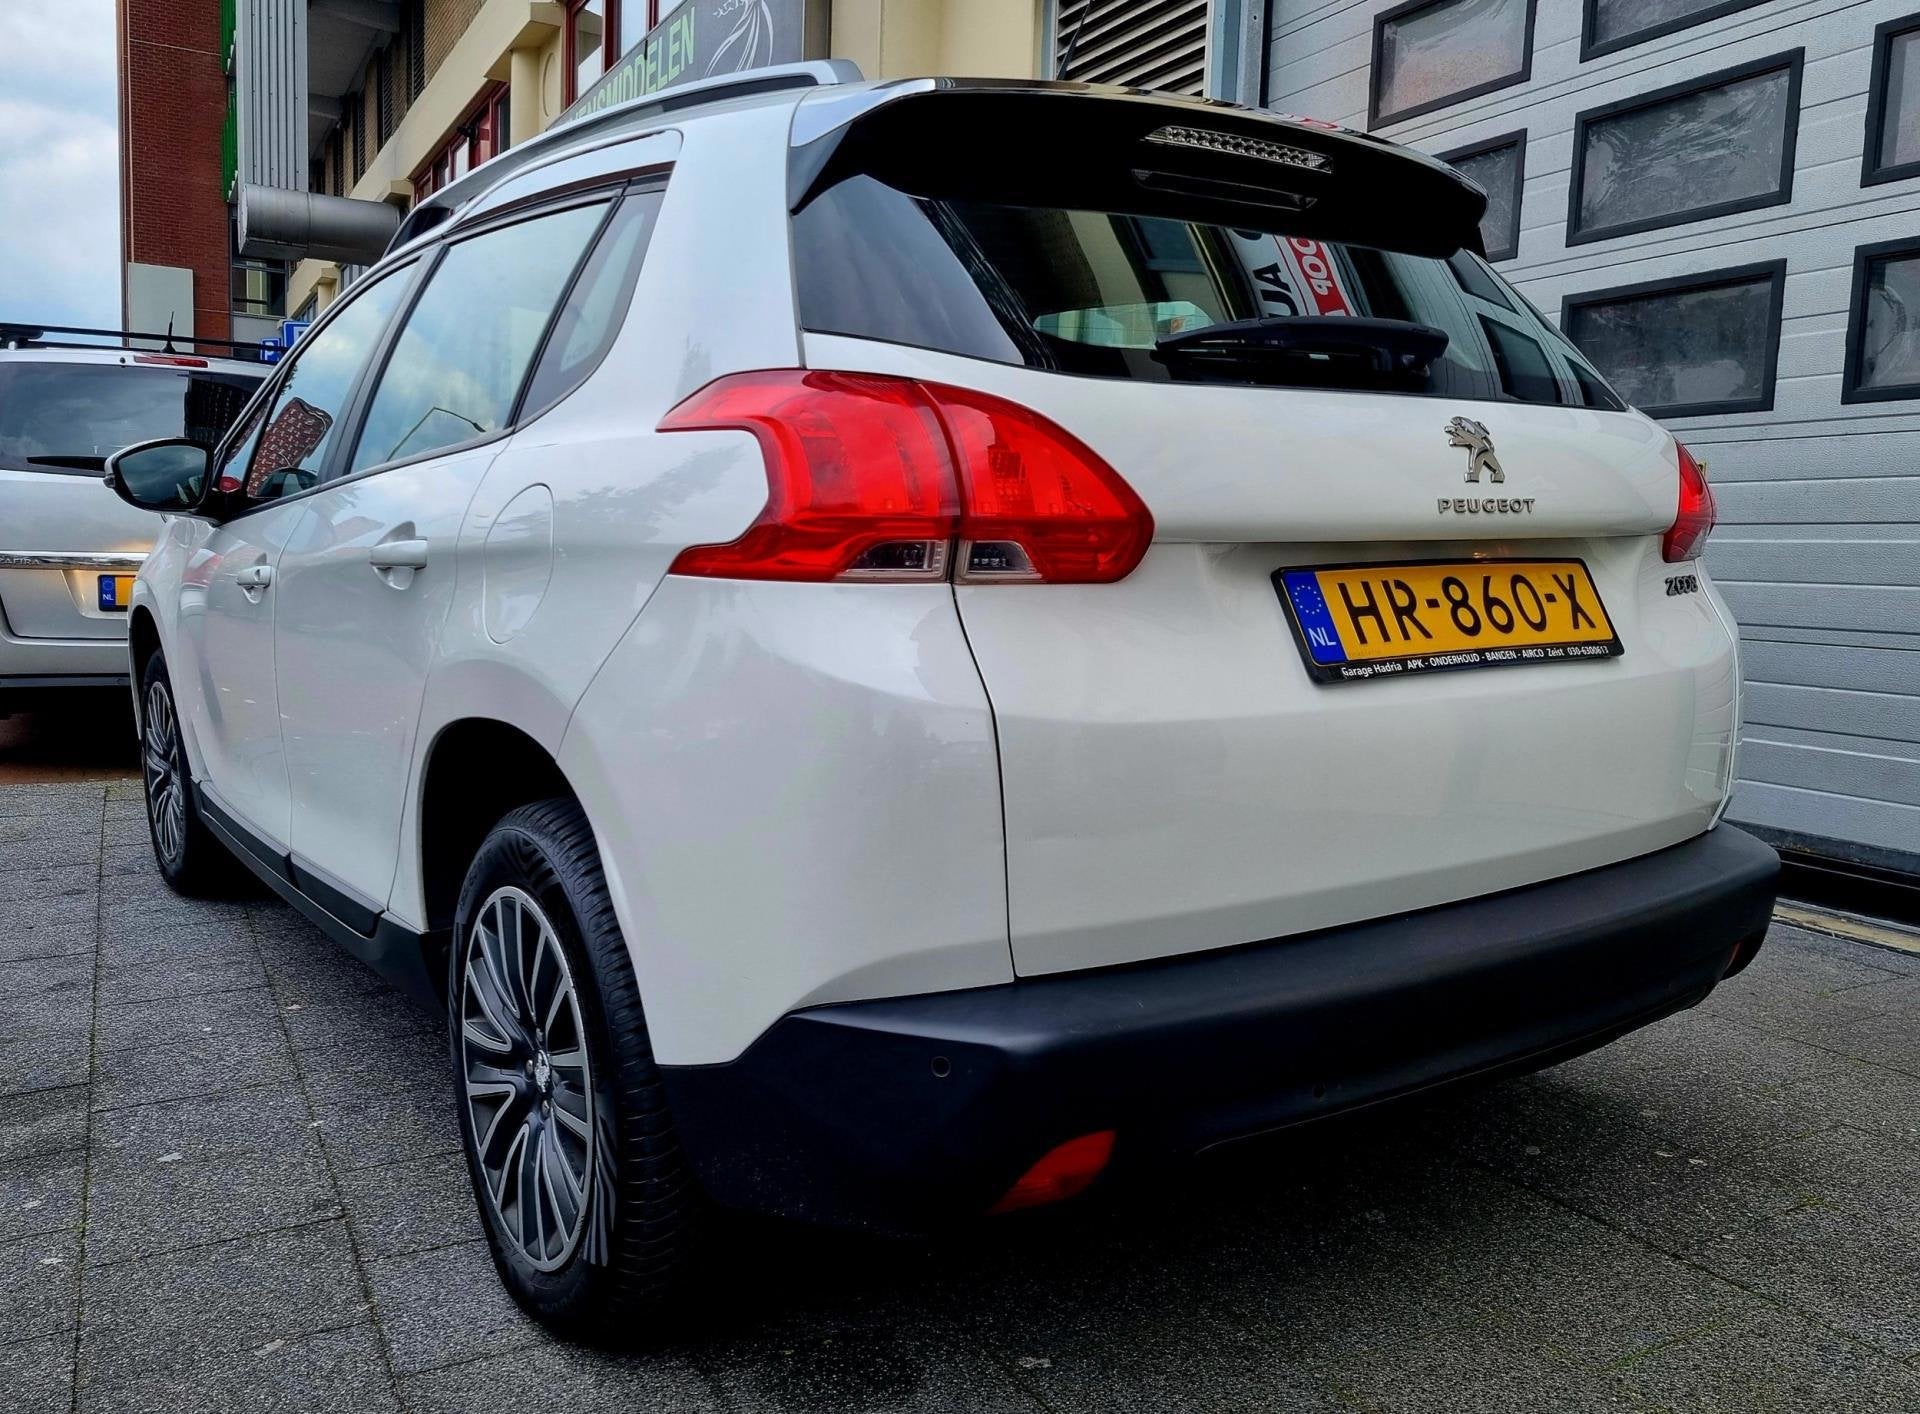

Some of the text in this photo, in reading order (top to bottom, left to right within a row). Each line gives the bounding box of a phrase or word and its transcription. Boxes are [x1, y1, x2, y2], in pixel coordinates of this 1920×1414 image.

[1437, 498, 1535, 514] PEUGEOT
[1665, 575, 1698, 596] 2008
[103, 592, 114, 601] NL
[1337, 573, 1596, 645] HR-860-X
[1309, 628, 1336, 647] NL
[1341, 666, 1373, 677] Garage
[1373, 662, 1402, 674] Hadria
[1407, 659, 1425, 670] APK
[1429, 653, 1480, 667] ONDERHOUD
[1485, 650, 1517, 661] BANDEN
[1522, 648, 1544, 658] AIRCO
[1547, 647, 1565, 657] Zeist
